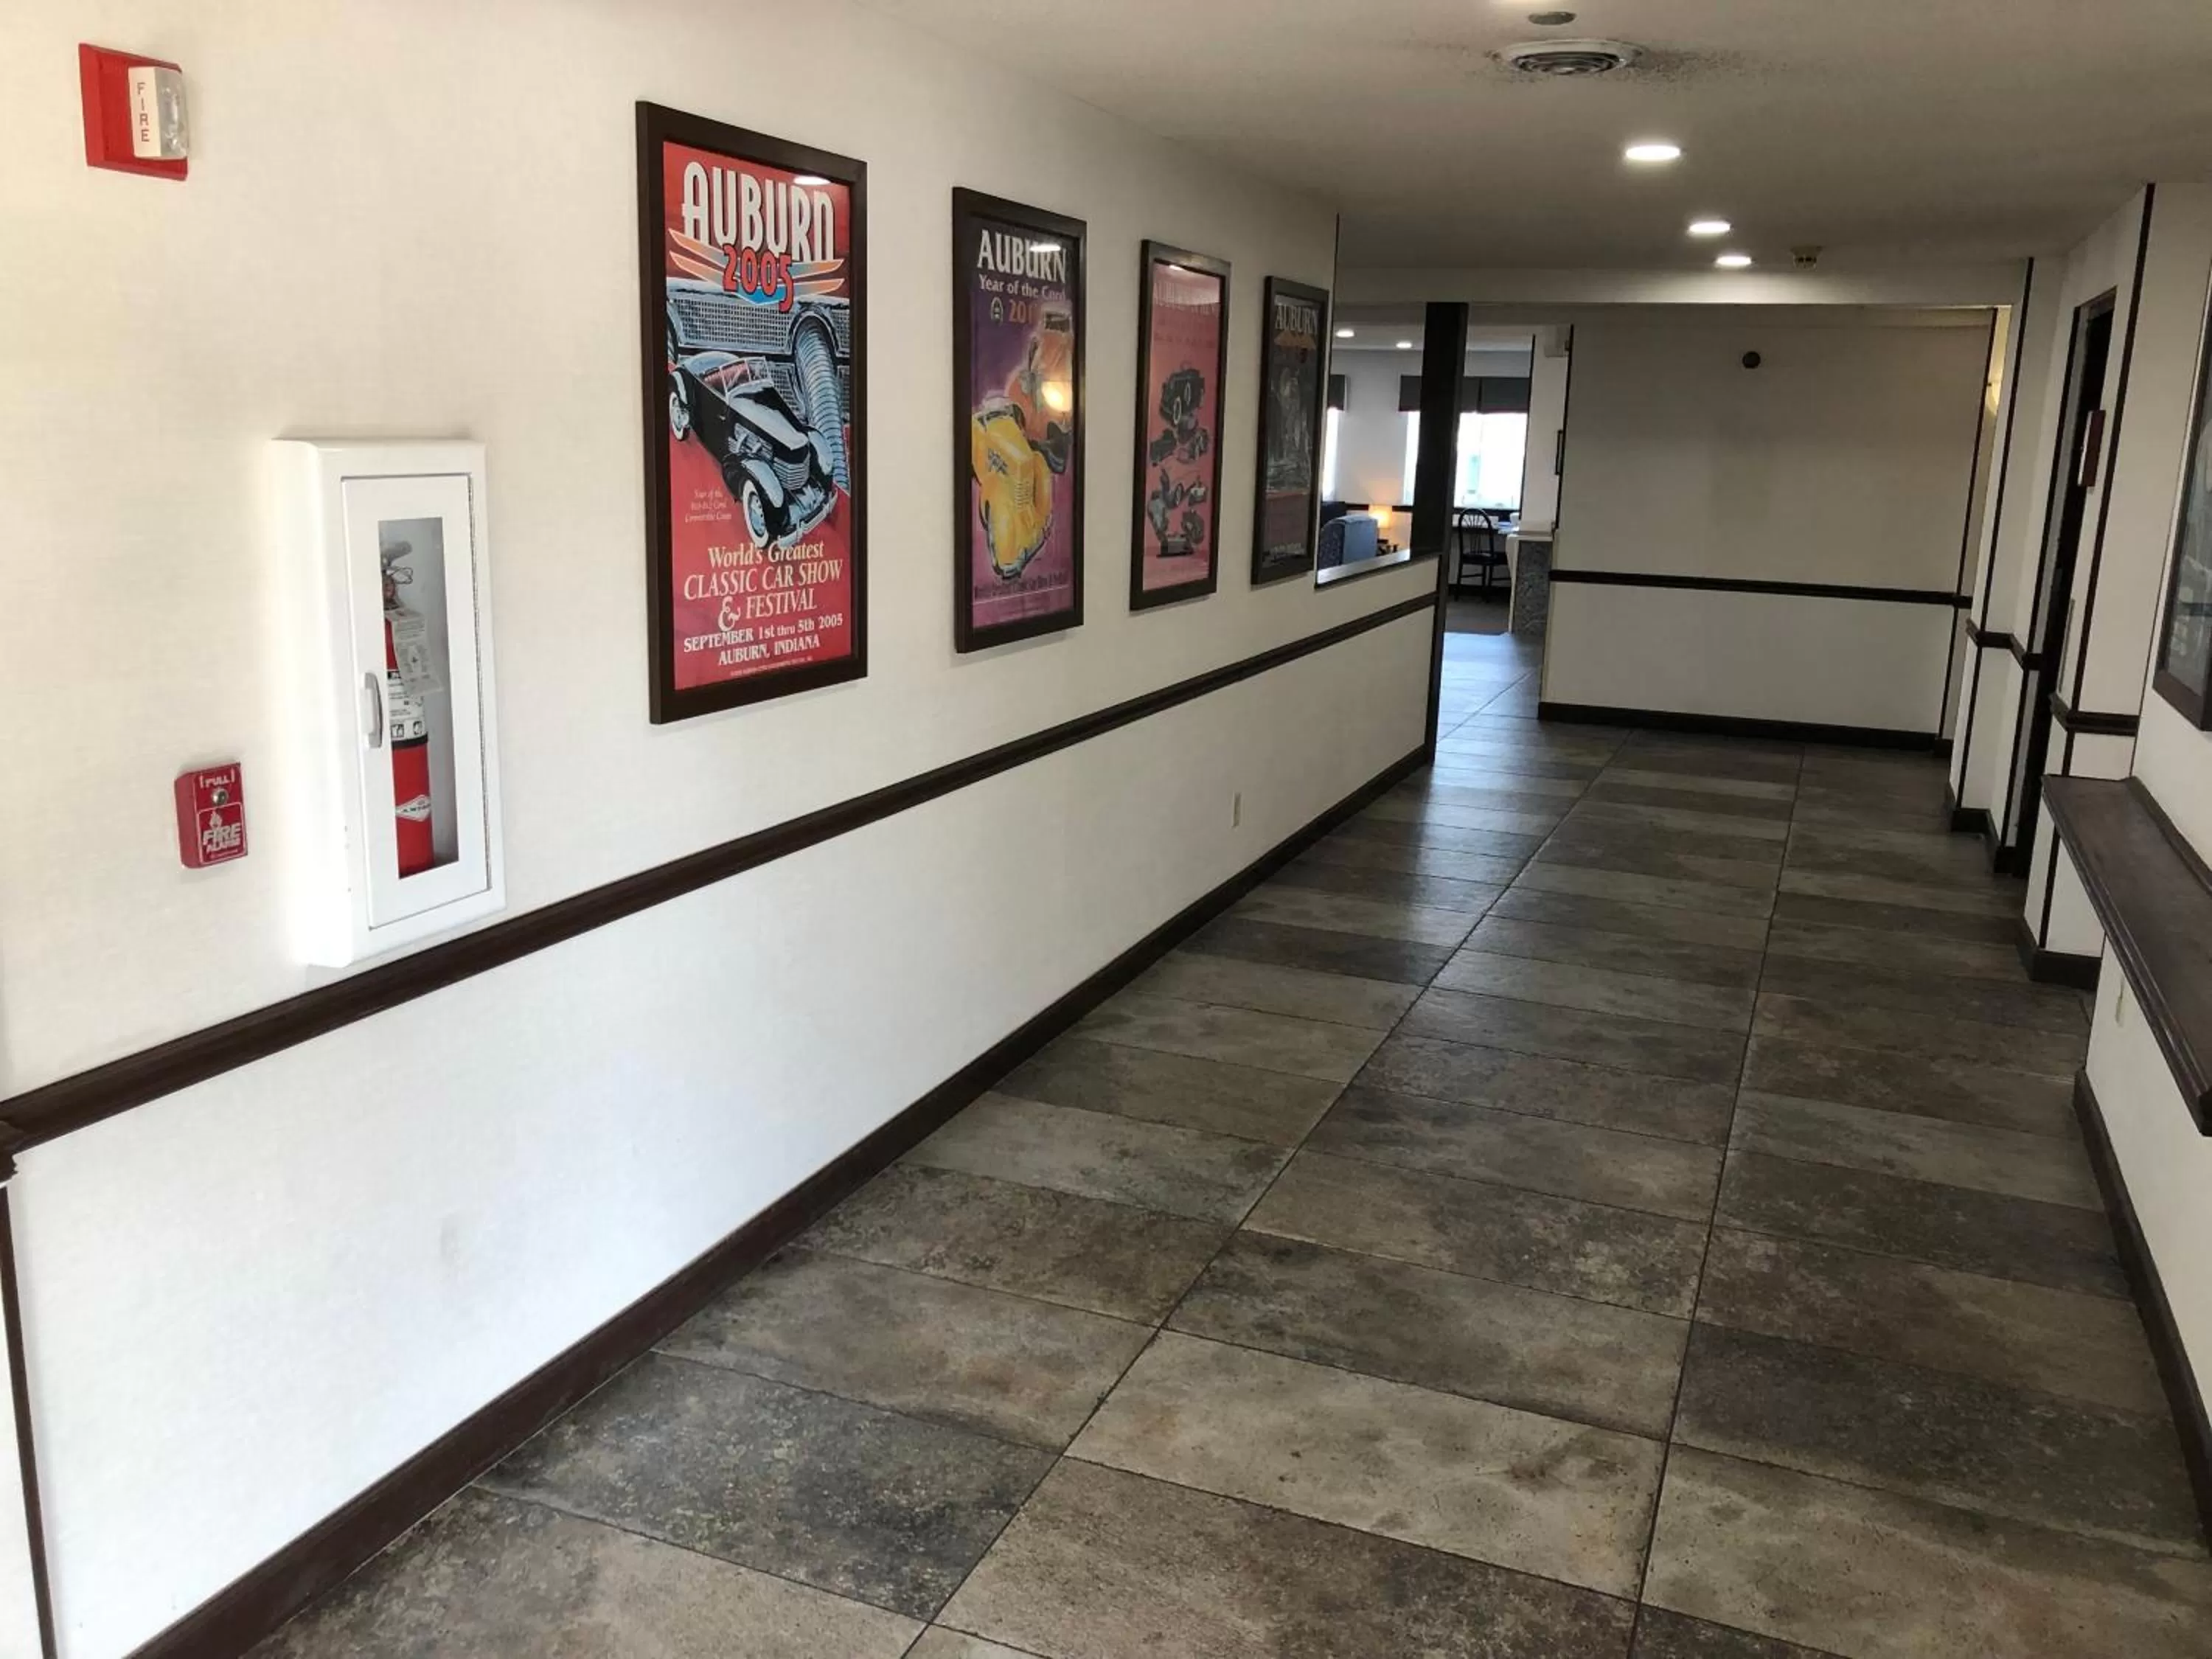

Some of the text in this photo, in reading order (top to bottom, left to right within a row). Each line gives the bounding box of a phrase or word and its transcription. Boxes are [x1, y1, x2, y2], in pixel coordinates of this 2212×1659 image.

[136, 82, 150, 142] FIRE
[681, 161, 835, 263] AUBURN
[976, 229, 1066, 284] AUBURN
[722, 243, 794, 313] 2005
[978, 274, 1066, 302] Year of the Cord
[1275, 304, 1318, 335] AUBURN
[708, 540, 824, 568] World's Greatest
[684, 558, 844, 600] CLASSIC CAR SHOW
[717, 588, 817, 632] & FESTIVAL
[684, 613, 843, 653] SEPTEMBER 1st thru 5th 2005
[719, 634, 820, 666] AUBURN, INDIANA
[205, 775, 230, 788] PULL
[203, 822, 241, 846] FIRE
